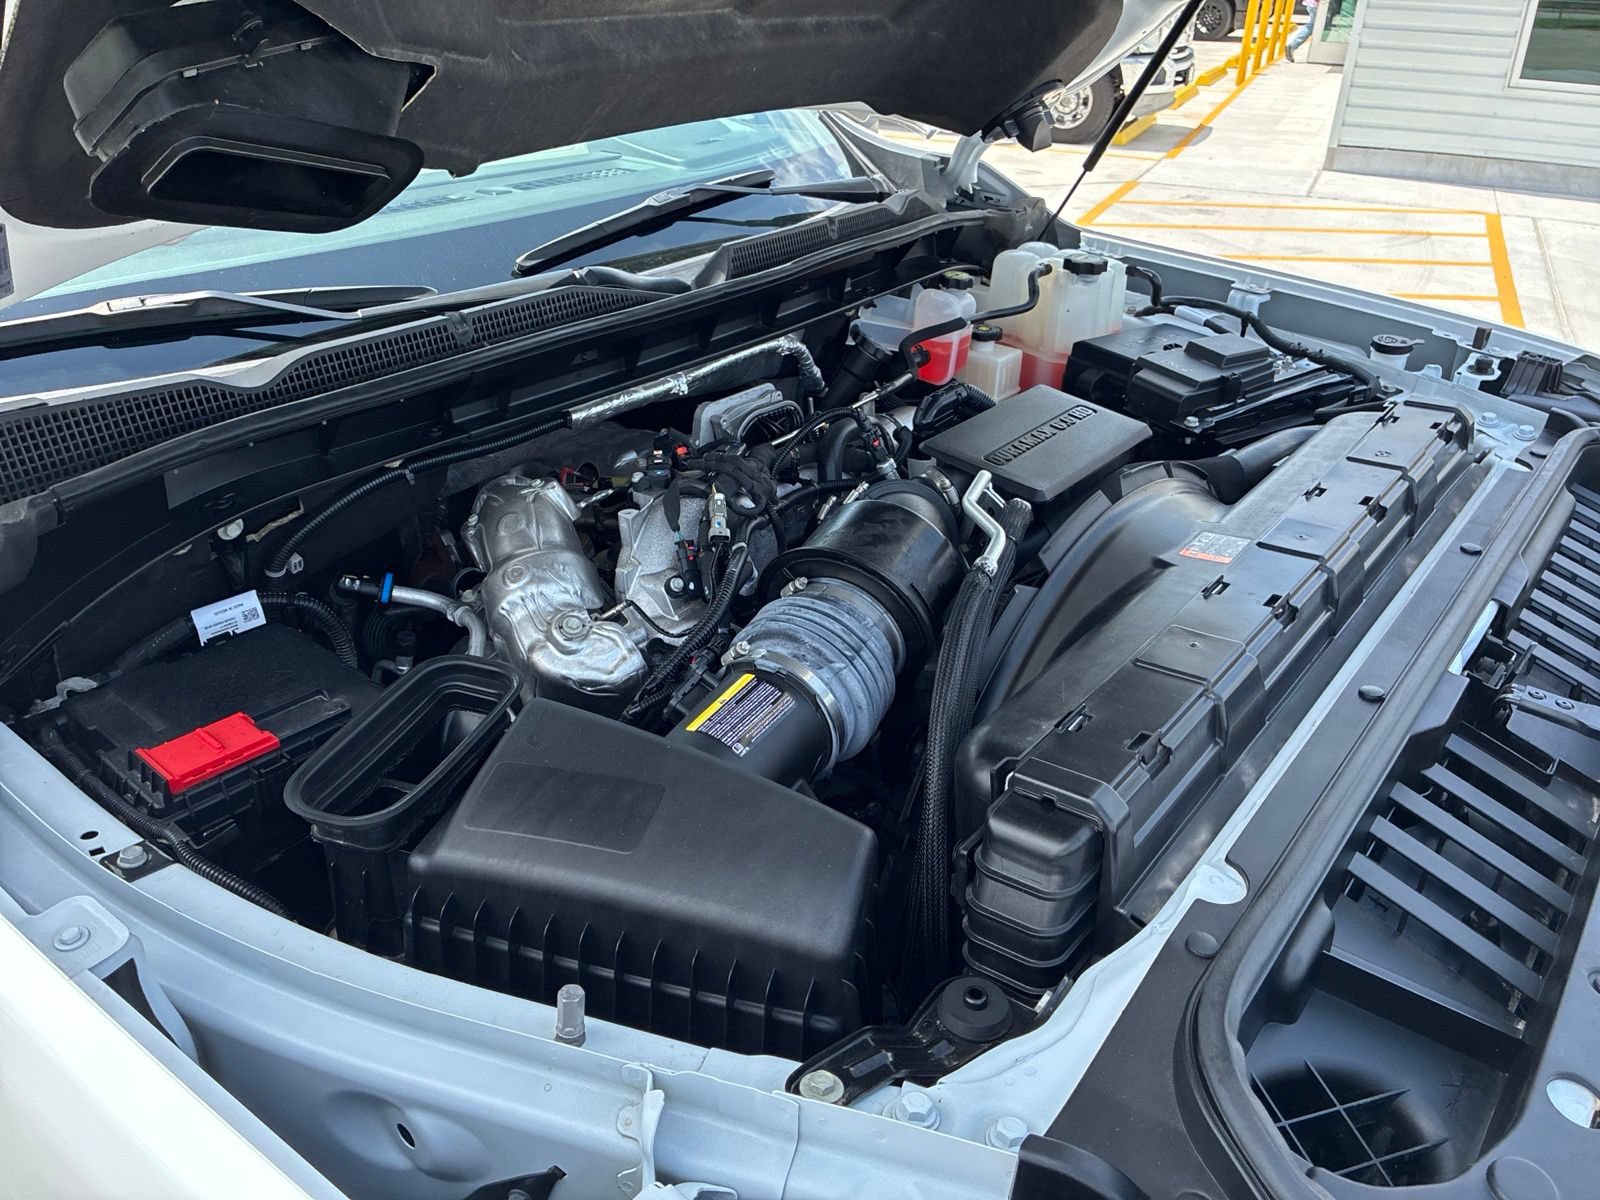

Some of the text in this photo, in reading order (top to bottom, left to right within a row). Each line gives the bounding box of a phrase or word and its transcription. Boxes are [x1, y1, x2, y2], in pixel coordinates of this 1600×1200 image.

[990, 407, 1093, 465] DURAMAX 6.6 HD
